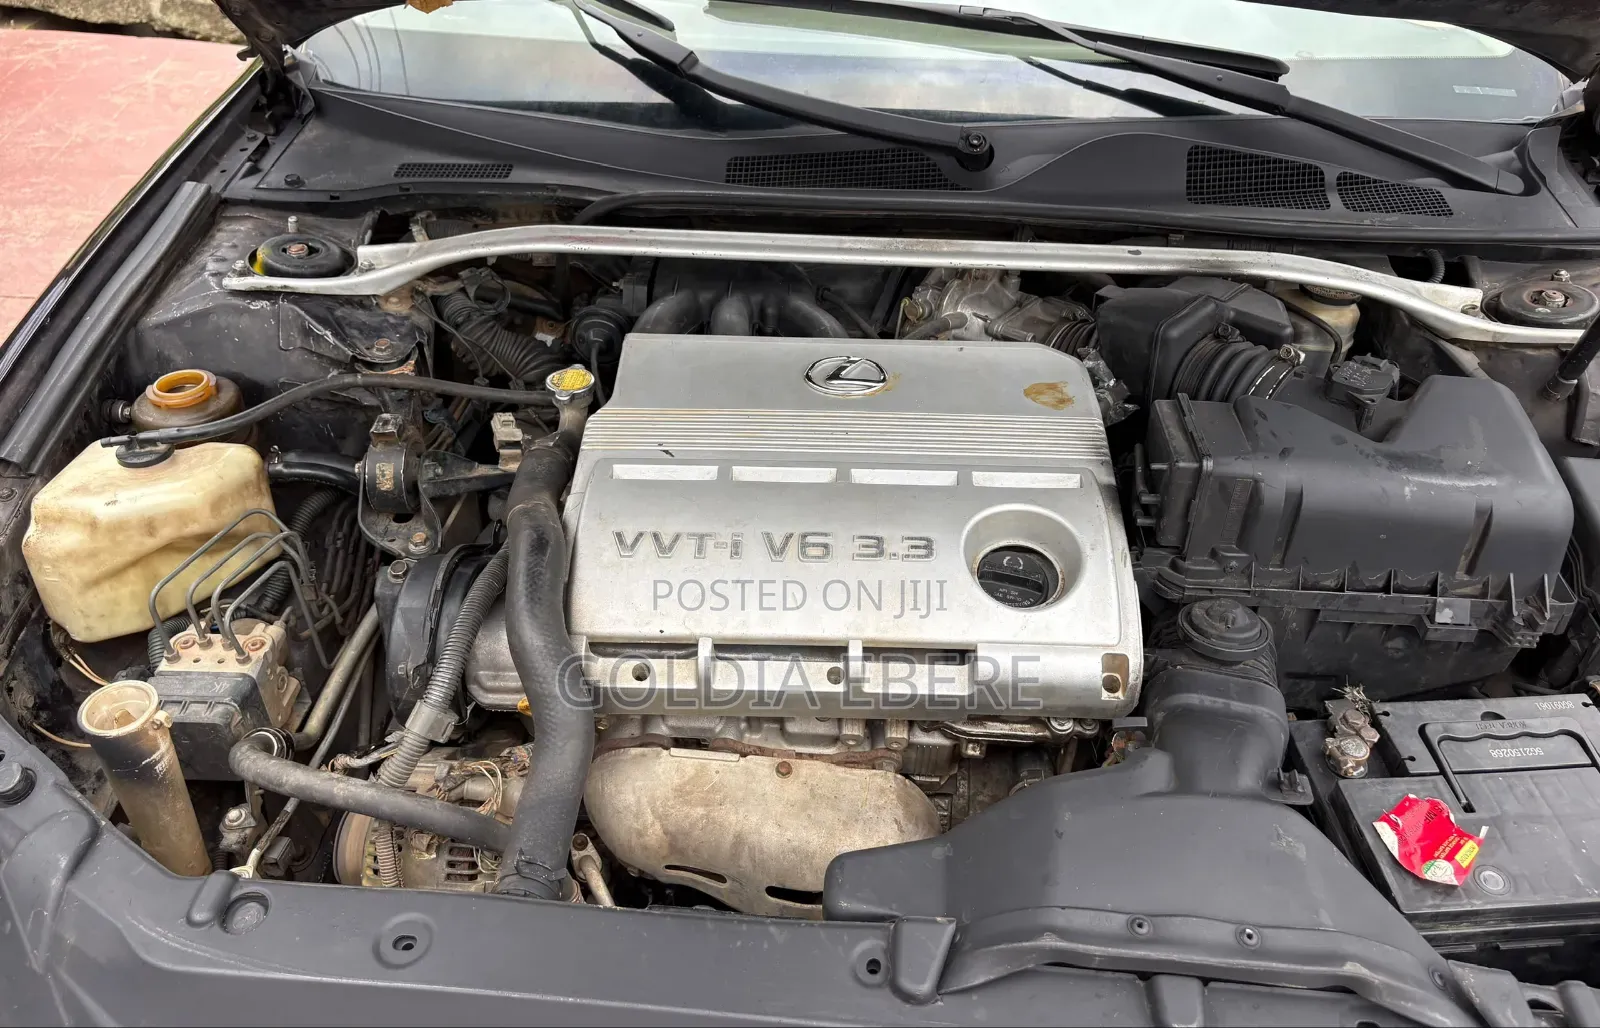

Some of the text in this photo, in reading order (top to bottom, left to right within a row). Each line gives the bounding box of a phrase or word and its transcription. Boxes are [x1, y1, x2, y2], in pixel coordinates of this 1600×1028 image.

[612, 531, 937, 563] VVT-i V6 3.3
[1490, 747, 1544, 758] 5G2150268
